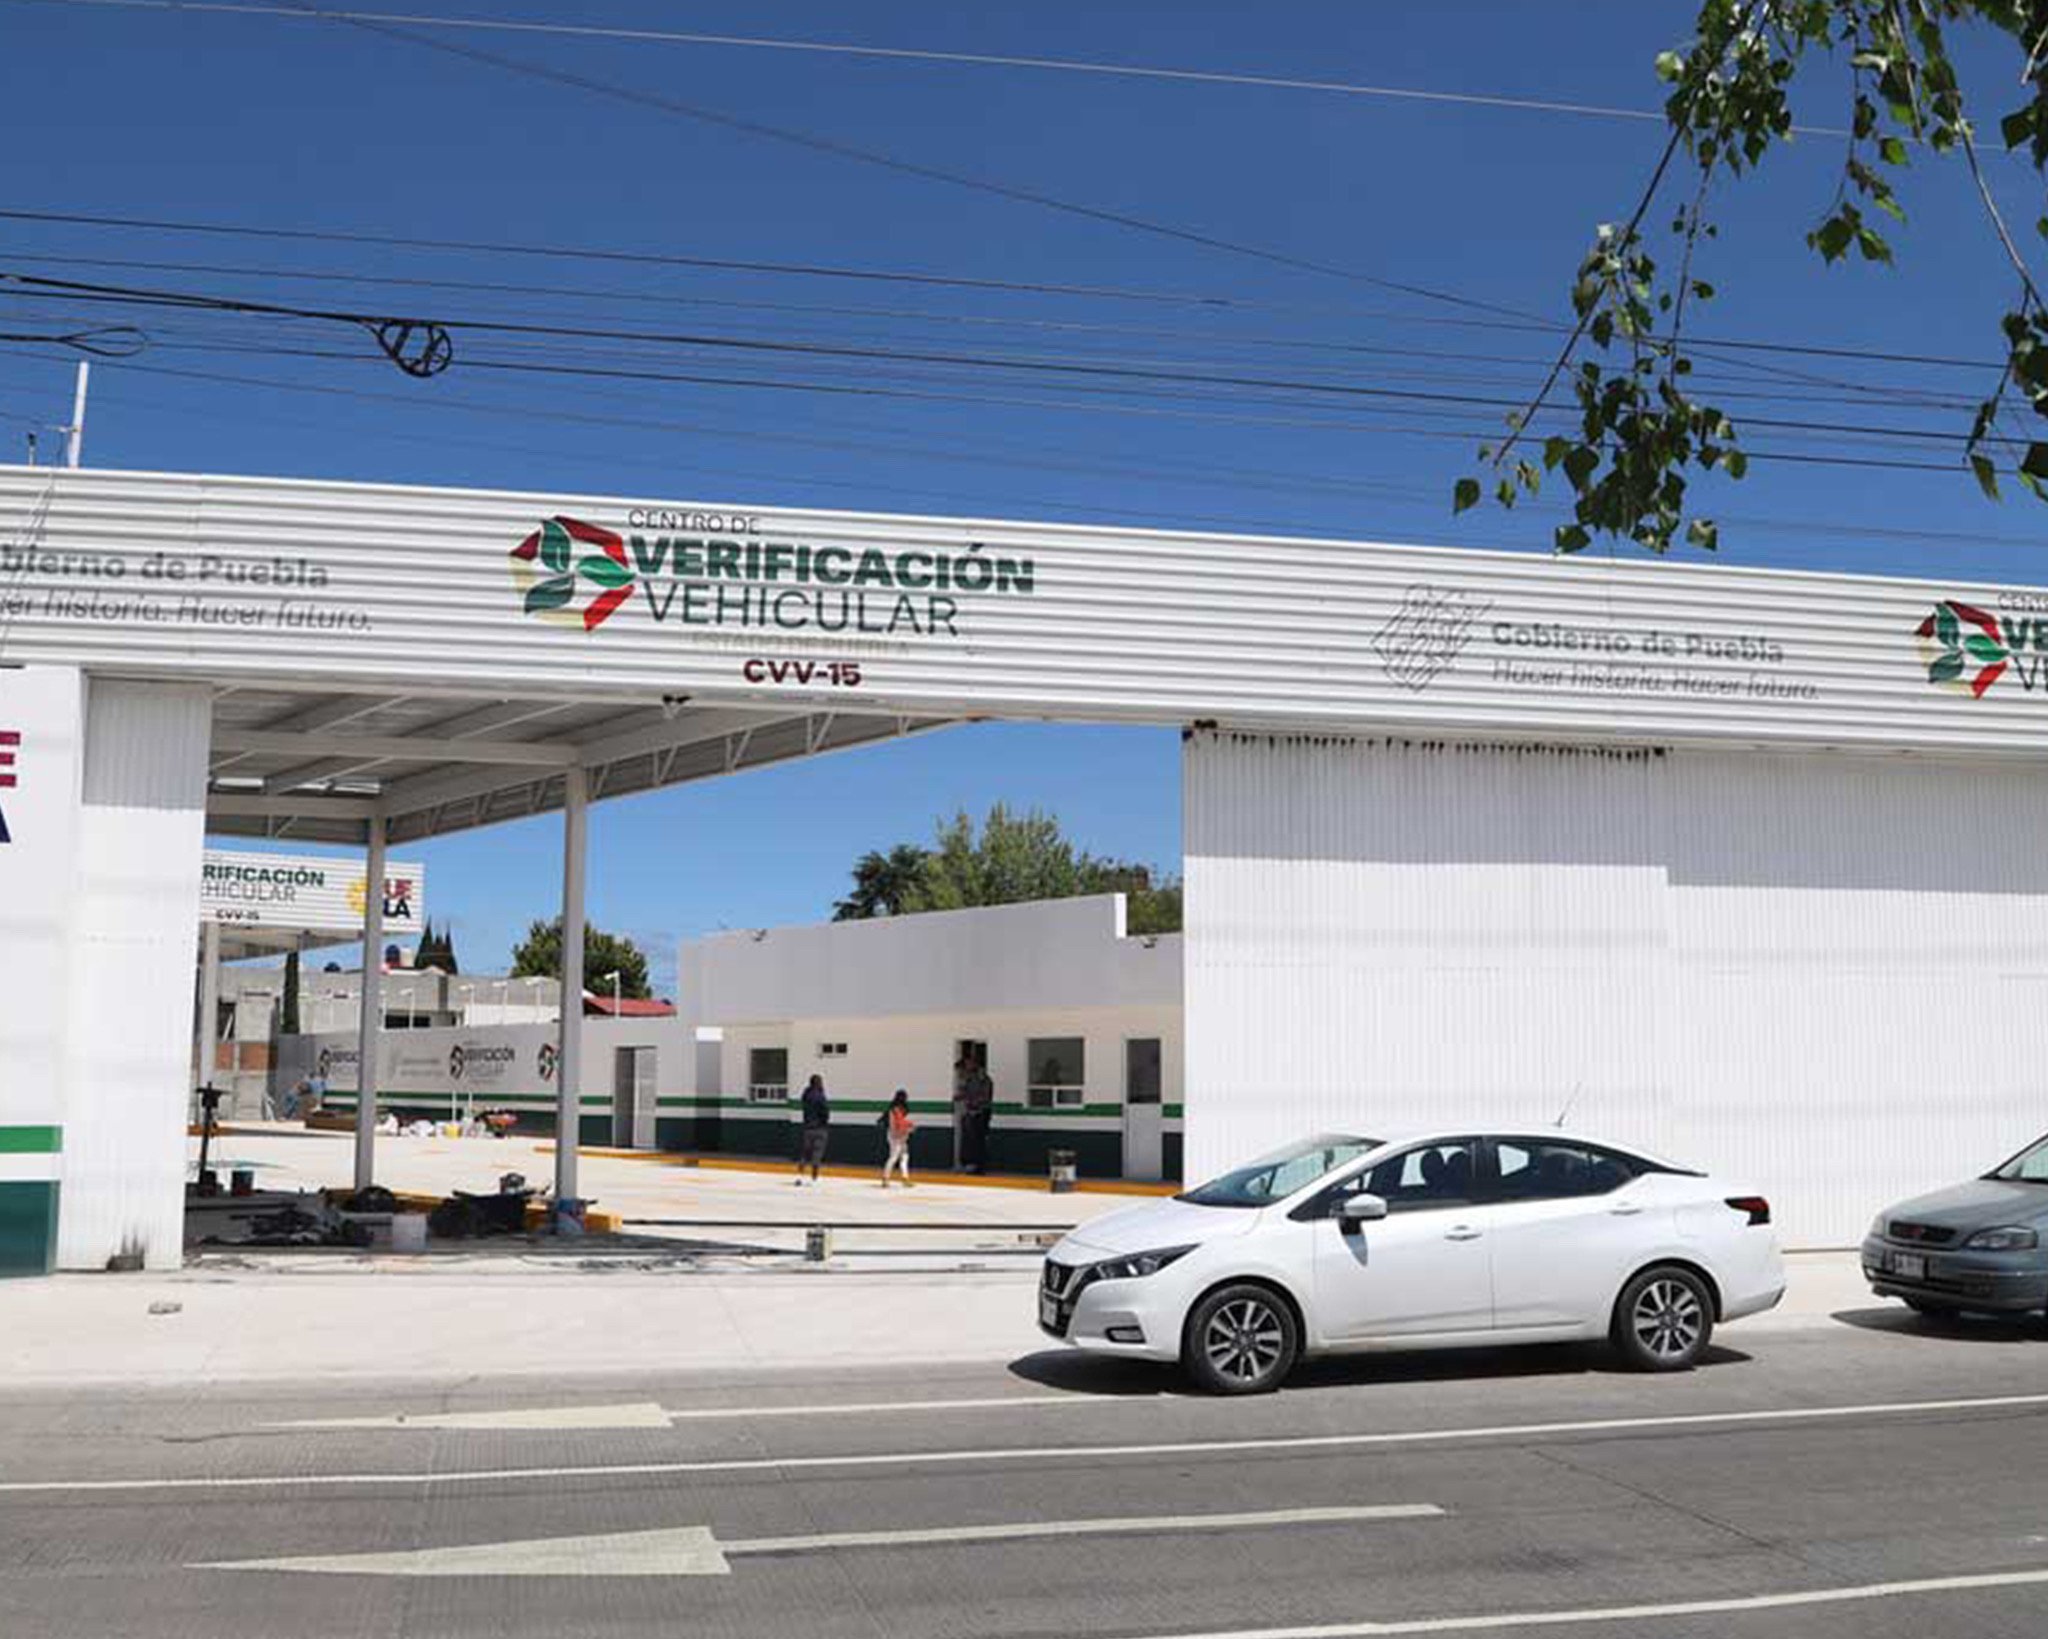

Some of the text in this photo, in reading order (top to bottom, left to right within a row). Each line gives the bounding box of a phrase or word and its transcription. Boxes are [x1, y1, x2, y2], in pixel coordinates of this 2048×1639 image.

[628, 509, 761, 535] CENTRO DE
[141, 551, 186, 580] de
[200, 556, 328, 587] Puebla
[630, 535, 1034, 592] VERIFICACIÓN
[644, 580, 958, 636] VEHICULAR
[1493, 622, 1783, 663] Gobierno de Puebla
[743, 659, 862, 686] CVV-15
[203, 864, 325, 887] RIFICACIÓN
